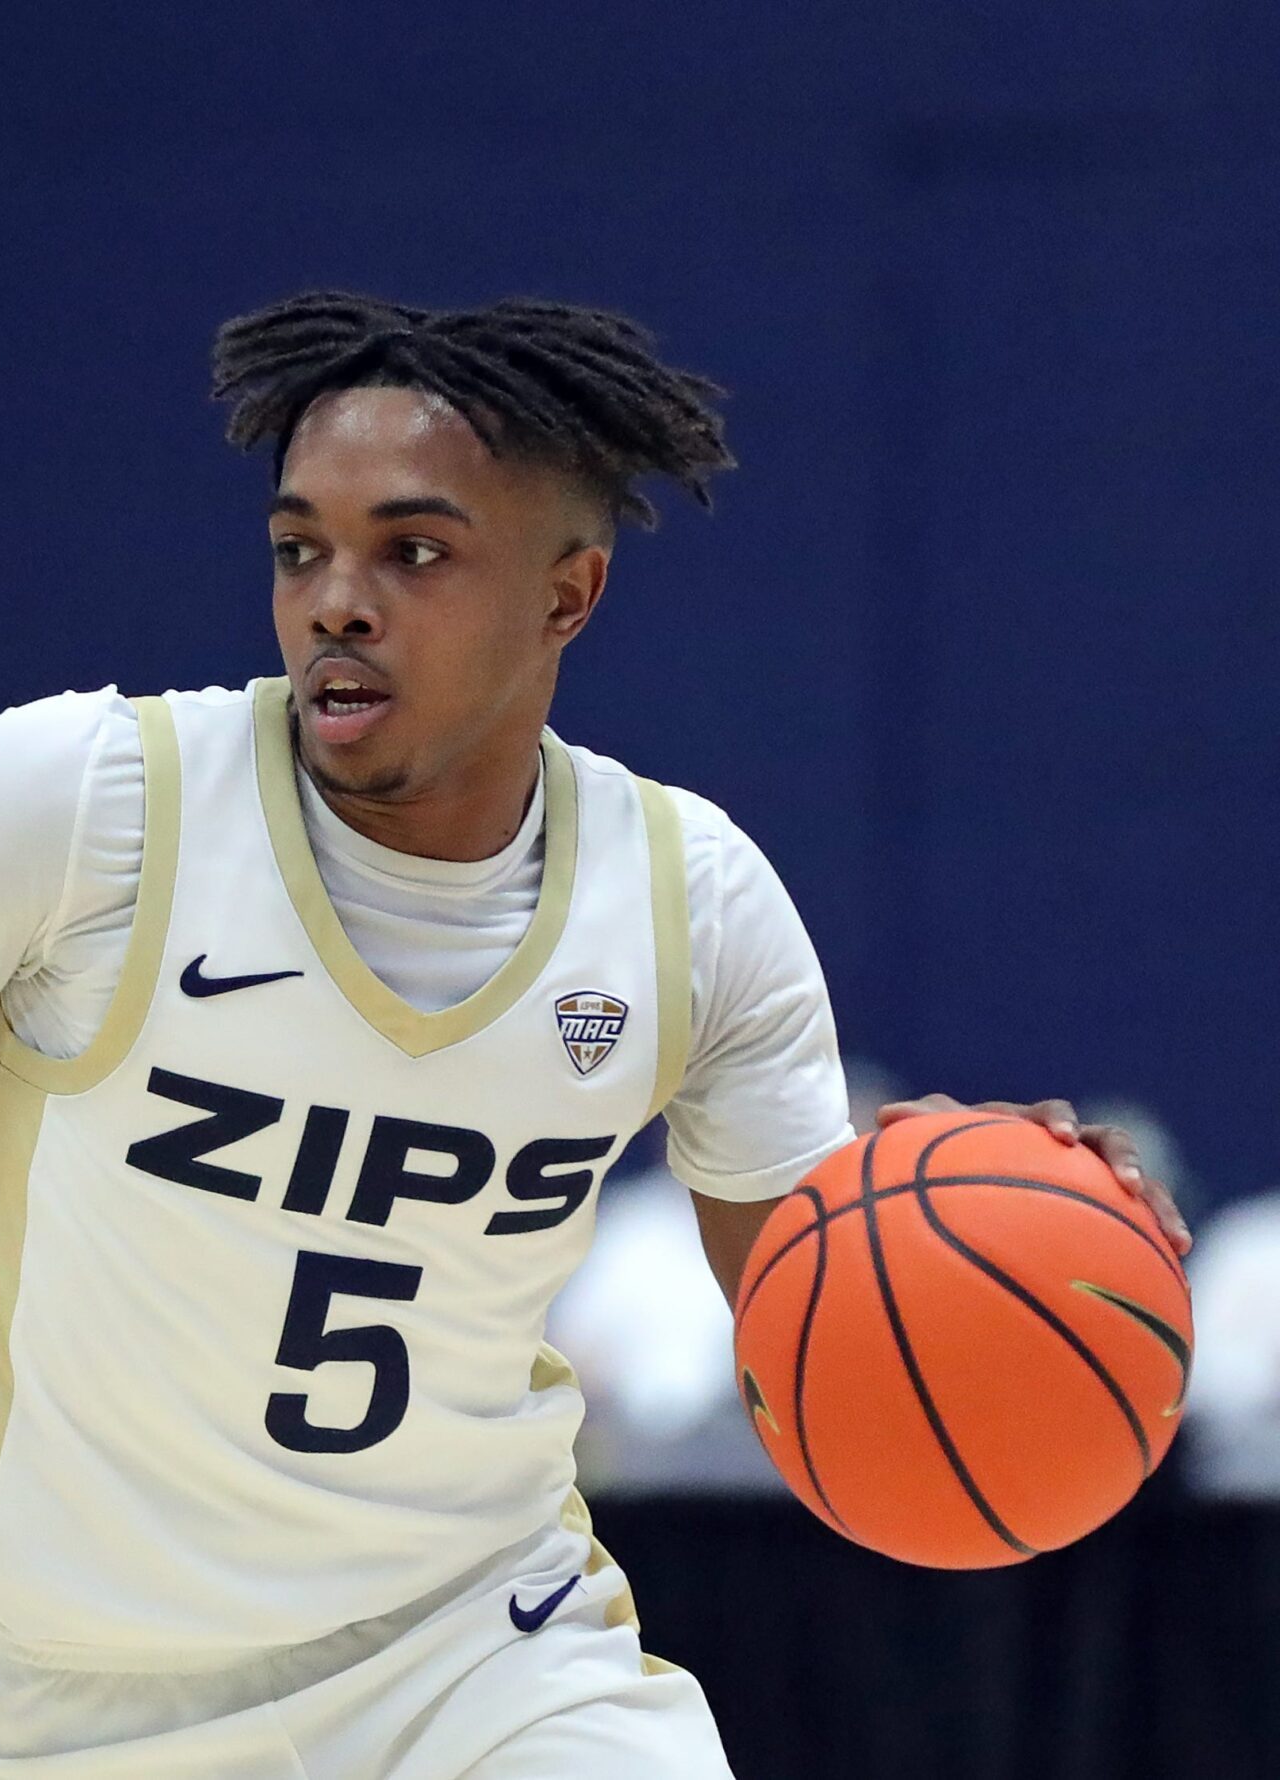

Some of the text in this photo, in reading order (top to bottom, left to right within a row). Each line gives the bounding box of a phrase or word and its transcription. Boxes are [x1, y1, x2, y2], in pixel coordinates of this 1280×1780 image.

[561, 1017, 622, 1040] MAC
[125, 1066, 617, 1235] ZIPS
[264, 1250, 423, 1454] 5
